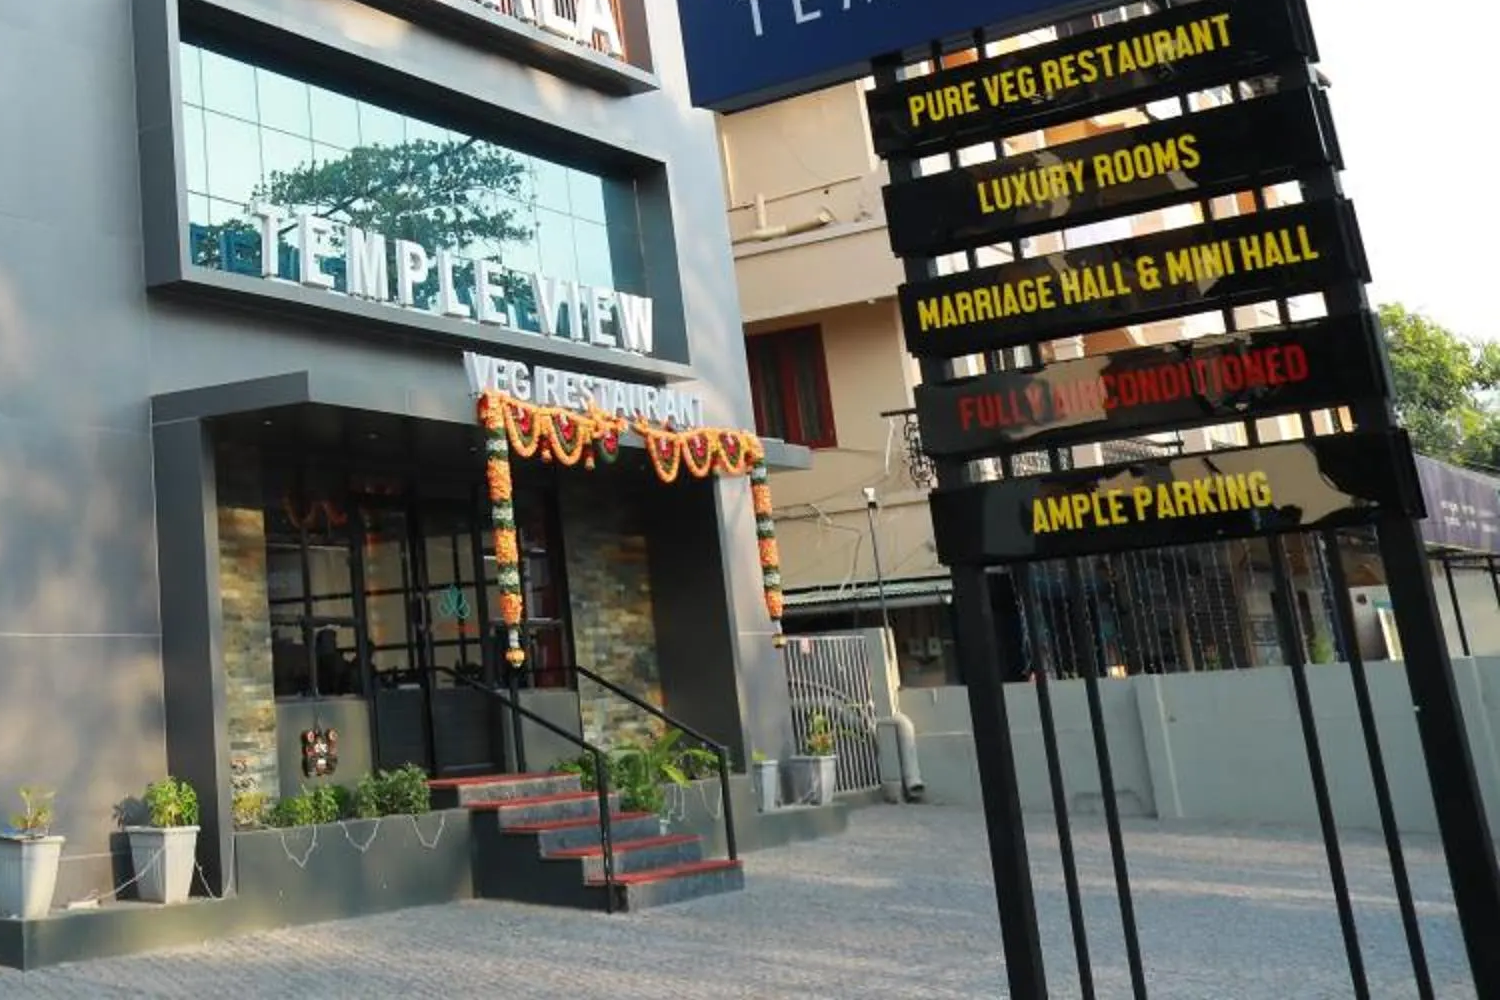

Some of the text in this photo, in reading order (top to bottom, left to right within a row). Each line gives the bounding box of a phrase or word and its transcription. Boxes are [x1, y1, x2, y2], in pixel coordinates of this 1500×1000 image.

[908, 14, 1232, 126] PURE VEG RESTAURANT
[978, 133, 1200, 214] LUXURY ROOMS
[251, 200, 653, 354] TEMPLE VIEW
[918, 225, 1318, 331] MARRIAGE HALL & MINI HALL
[463, 350, 704, 427] VEG RESTAURANT
[958, 383, 1045, 431] FULLY
[1032, 471, 1274, 534] AMPLE PARKING
